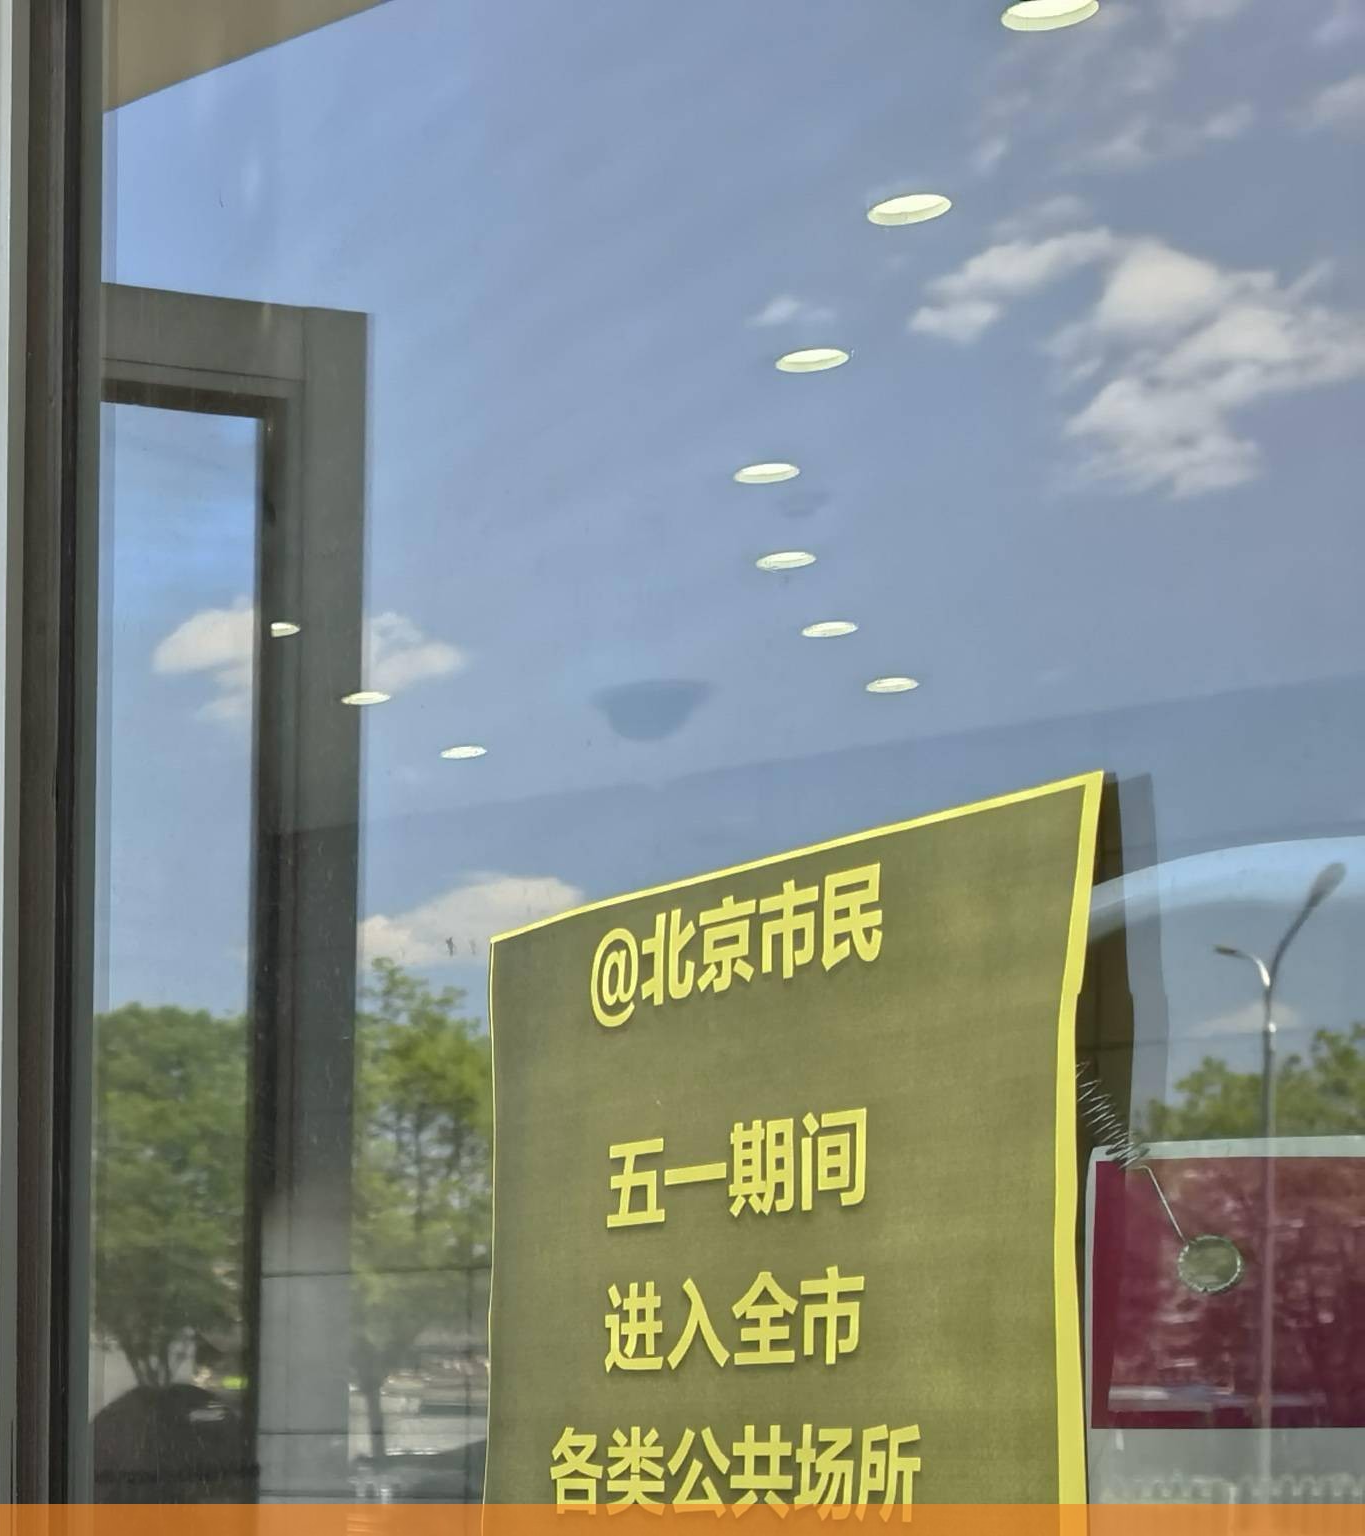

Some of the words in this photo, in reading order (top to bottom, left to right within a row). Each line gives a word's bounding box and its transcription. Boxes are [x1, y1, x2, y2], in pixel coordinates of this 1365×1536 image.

[590, 862, 885, 1028] @北京市民
[606, 1106, 868, 1229] 五一期间
[604, 1265, 866, 1373] 进入全市
[549, 1423, 922, 1524] 各类公共场所
